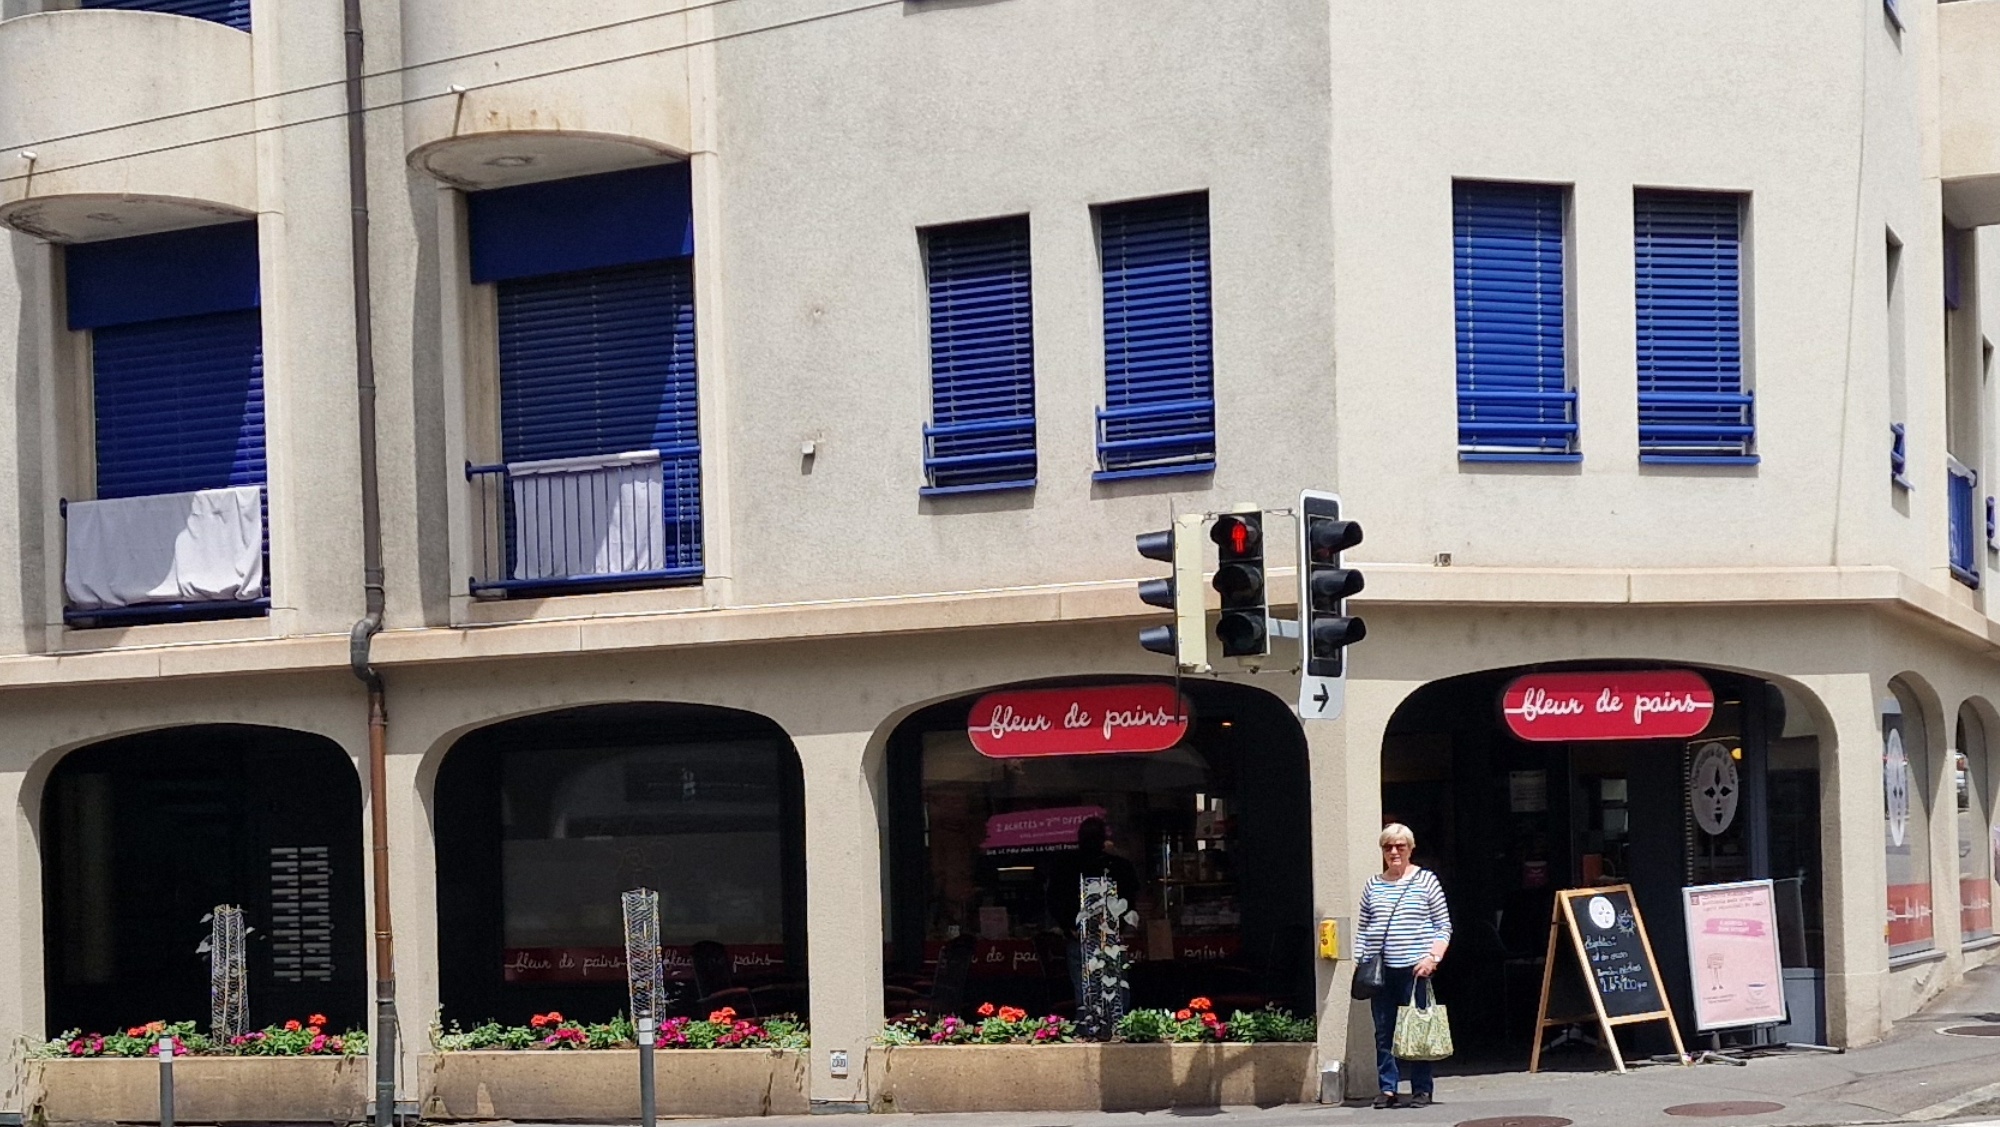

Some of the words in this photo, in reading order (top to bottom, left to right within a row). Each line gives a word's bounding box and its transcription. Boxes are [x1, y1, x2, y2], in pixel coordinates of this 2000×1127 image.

[1521, 687, 1584, 721] fleur
[1596, 688, 1623, 712] de
[1633, 691, 1697, 724] pains
[988, 705, 1051, 739] fleur
[1063, 702, 1092, 728] de
[1102, 705, 1169, 740] pains
[516, 952, 552, 972] fleur
[558, 953, 576, 967] de
[583, 954, 622, 976] pains
[732, 952, 771, 974] pains
[986, 945, 1005, 963] de
